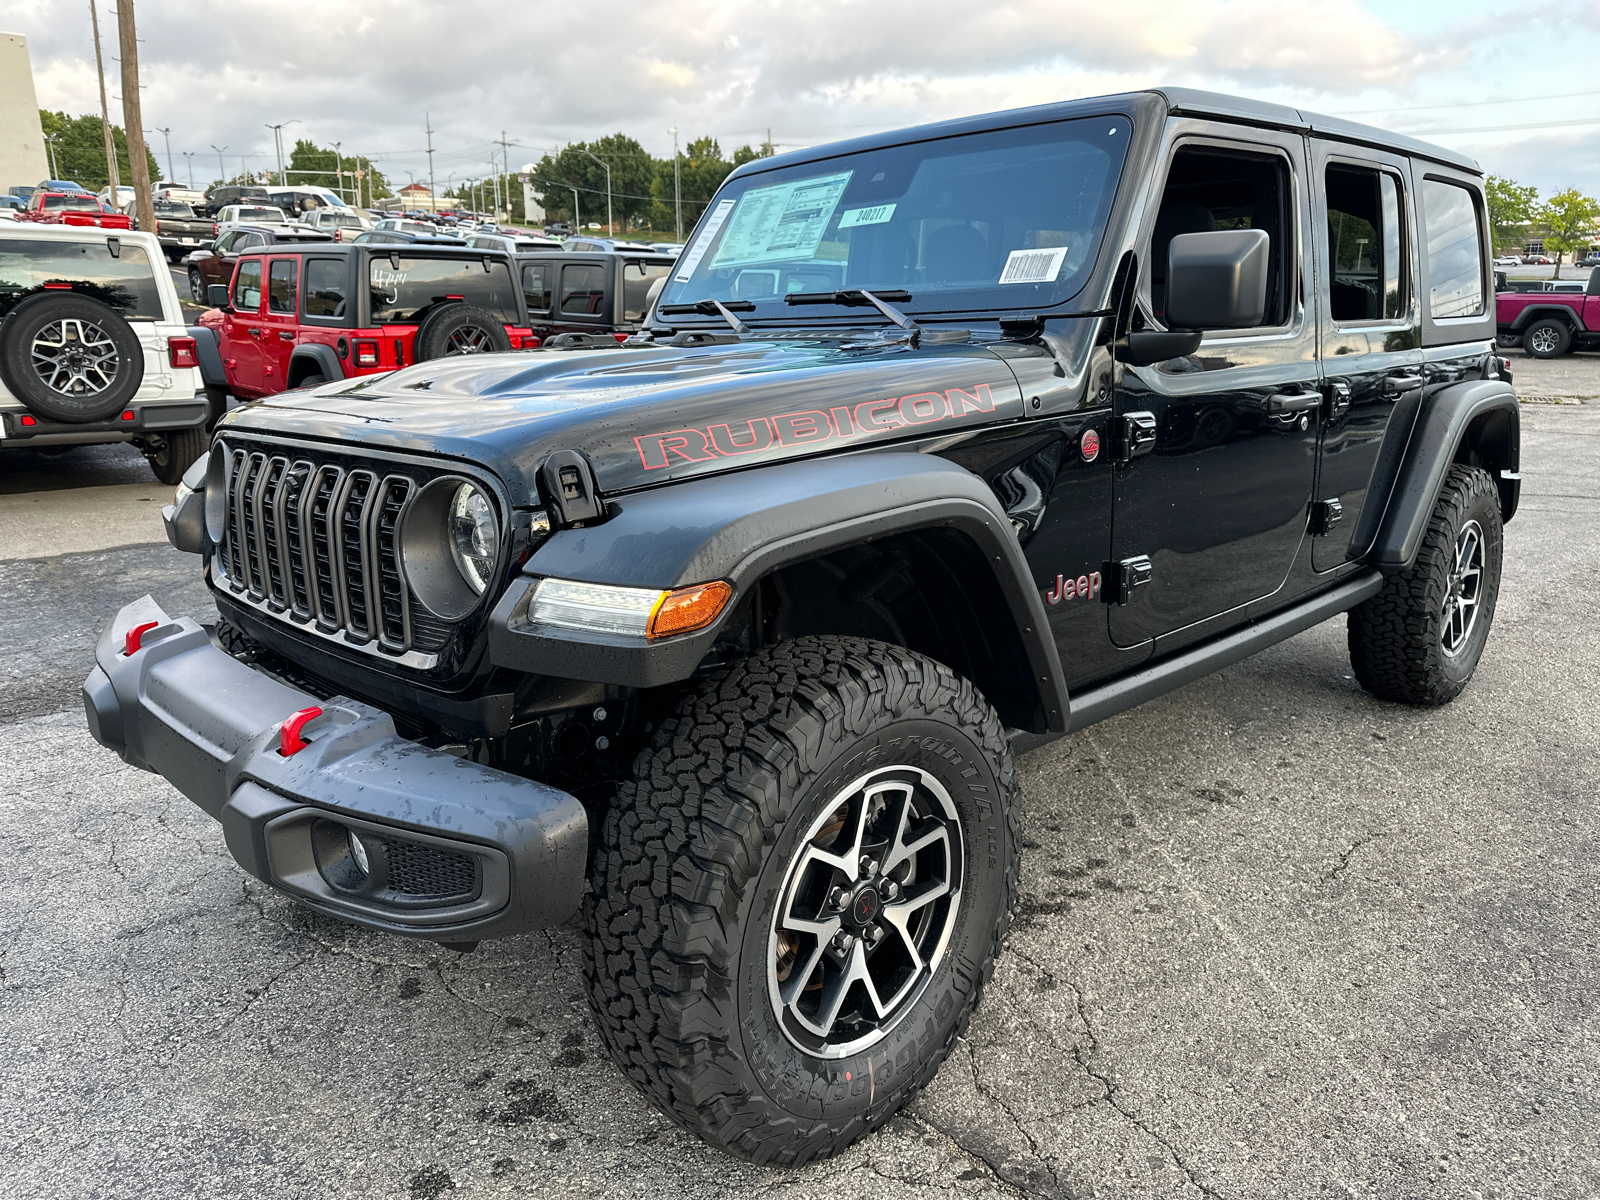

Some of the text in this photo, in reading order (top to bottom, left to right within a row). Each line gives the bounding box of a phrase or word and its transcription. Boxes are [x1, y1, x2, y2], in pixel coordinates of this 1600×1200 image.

[856, 207, 887, 222] 240217
[374, 269, 407, 288] 4744
[634, 384, 996, 470] RUBICON
[1046, 571, 1102, 605] Jeep
